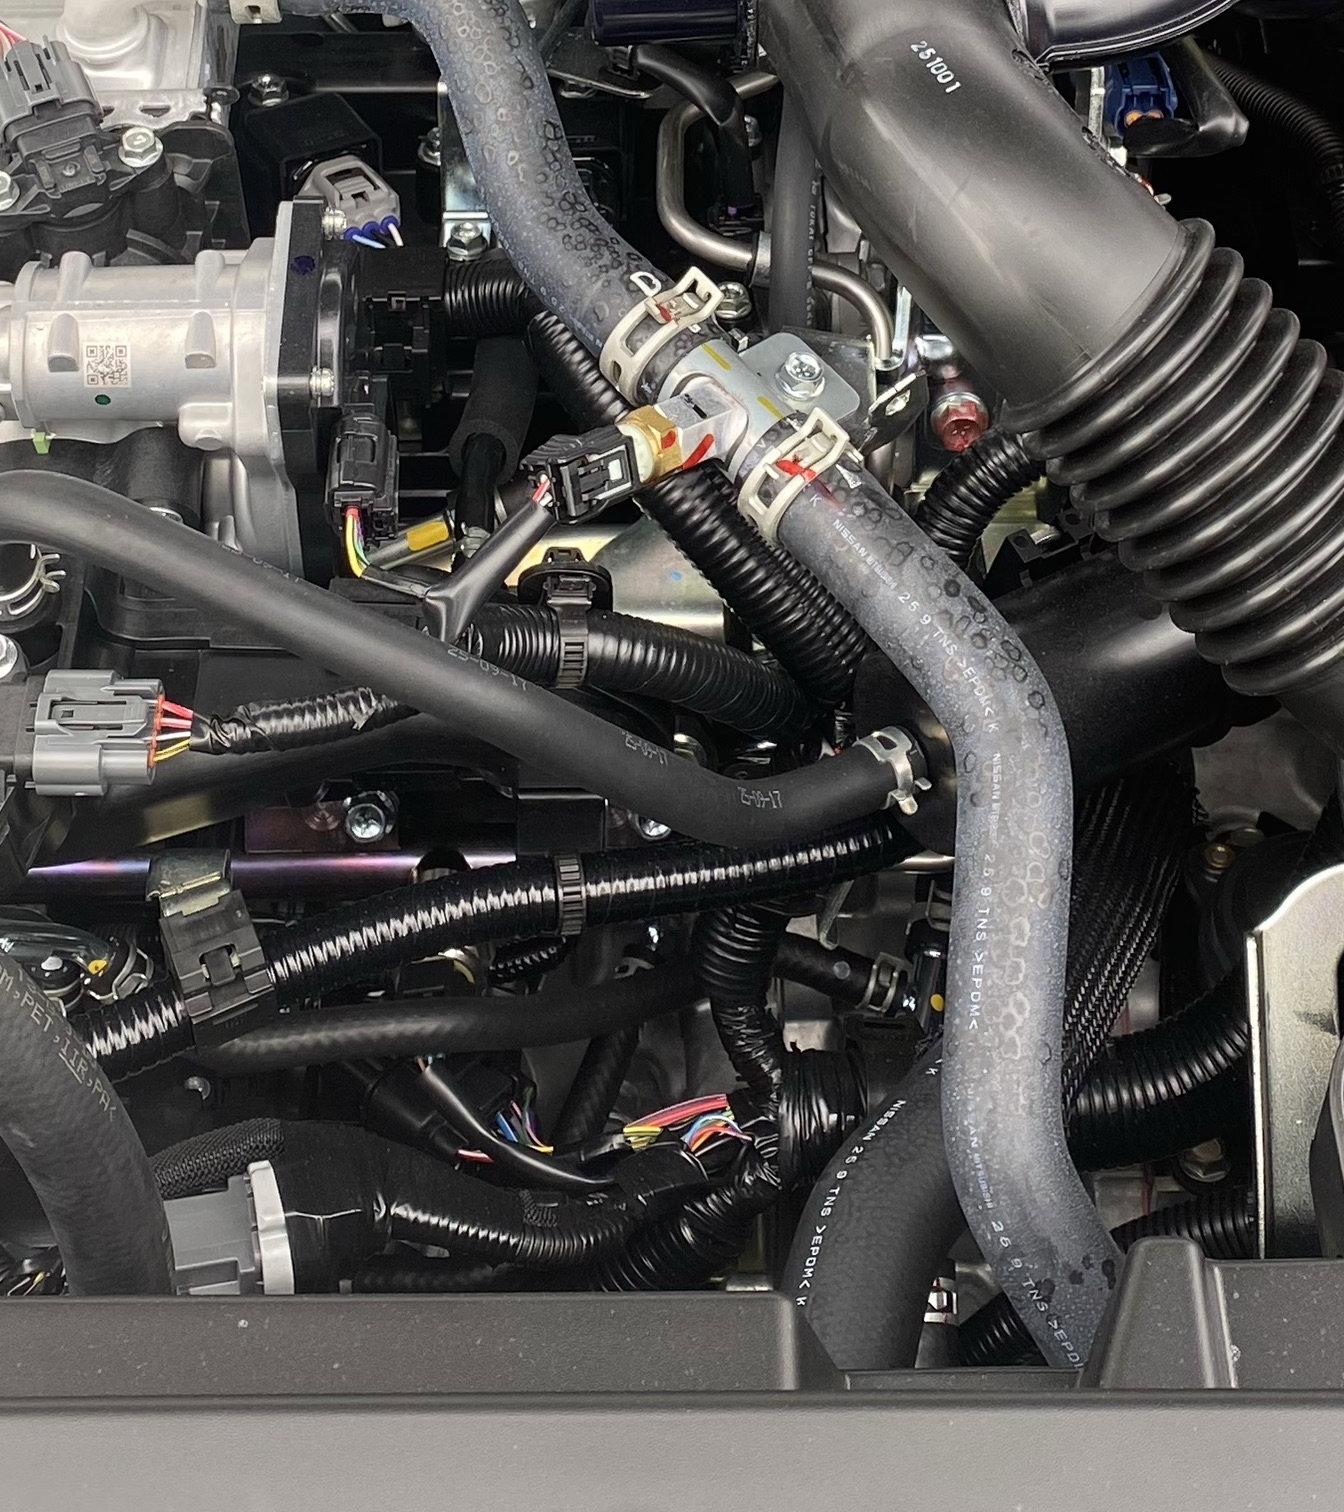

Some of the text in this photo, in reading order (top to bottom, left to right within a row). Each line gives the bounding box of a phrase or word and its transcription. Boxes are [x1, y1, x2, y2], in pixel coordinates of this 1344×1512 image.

[910, 40, 962, 93] 251001
[809, 494, 823, 509] K
[832, 518, 868, 558] NISSAN
[932, 625, 958, 656] TNS
[447, 647, 528, 692] 25-09-17
[956, 657, 995, 718] >EPDM<
[990, 752, 1003, 802] NISSAN
[975, 906, 991, 942] TNS
[968, 951, 985, 1032] >EPDM<
[862, 1099, 907, 1141] NISSAN
[820, 1186, 841, 1217] TNS
[798, 1224, 827, 1289] >EPDM<
[795, 1295, 807, 1307] K
[1021, 1278, 1049, 1313] TNS
